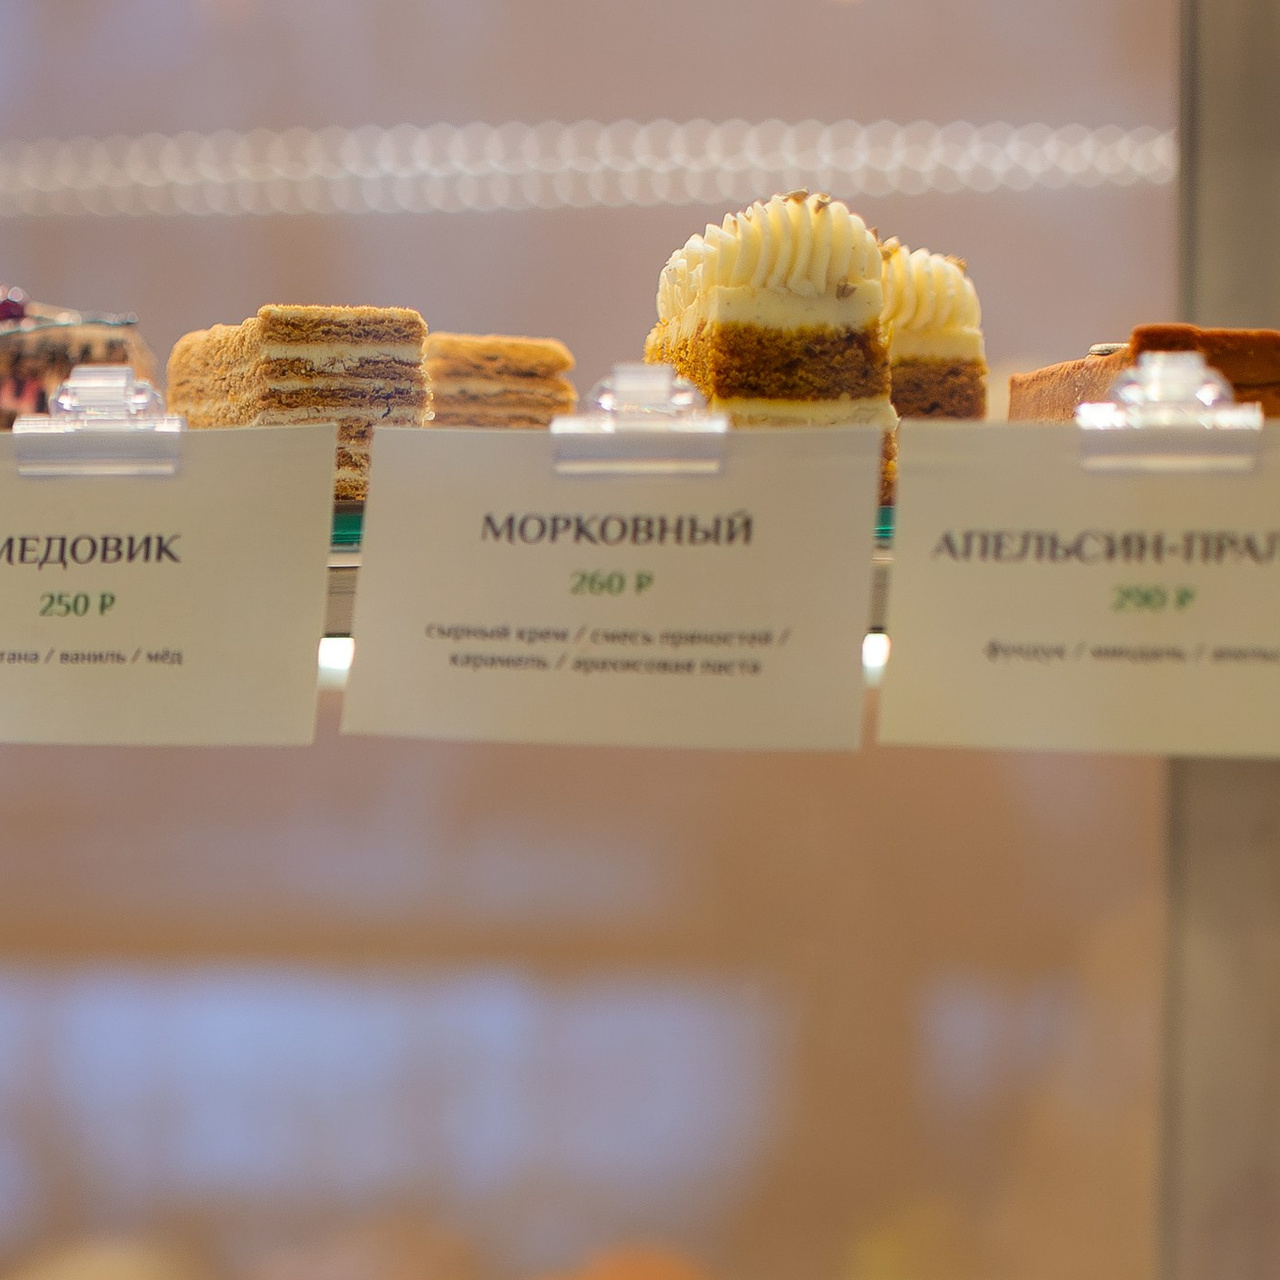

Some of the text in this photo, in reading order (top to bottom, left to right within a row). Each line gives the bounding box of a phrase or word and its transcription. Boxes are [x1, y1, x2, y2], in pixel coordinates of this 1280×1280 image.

[481, 509, 754, 545] МОРКОВНЫЙ
[569, 570, 626, 595] 260
[39, 592, 89, 617] 250
[426, 623, 510, 641] сырный
[516, 626, 569, 644] крем
[590, 627, 653, 645] смесь
[60, 650, 127, 665] ваниль
[146, 648, 183, 666] мёд
[449, 653, 549, 671] карамель
[700, 659, 762, 675] паста
